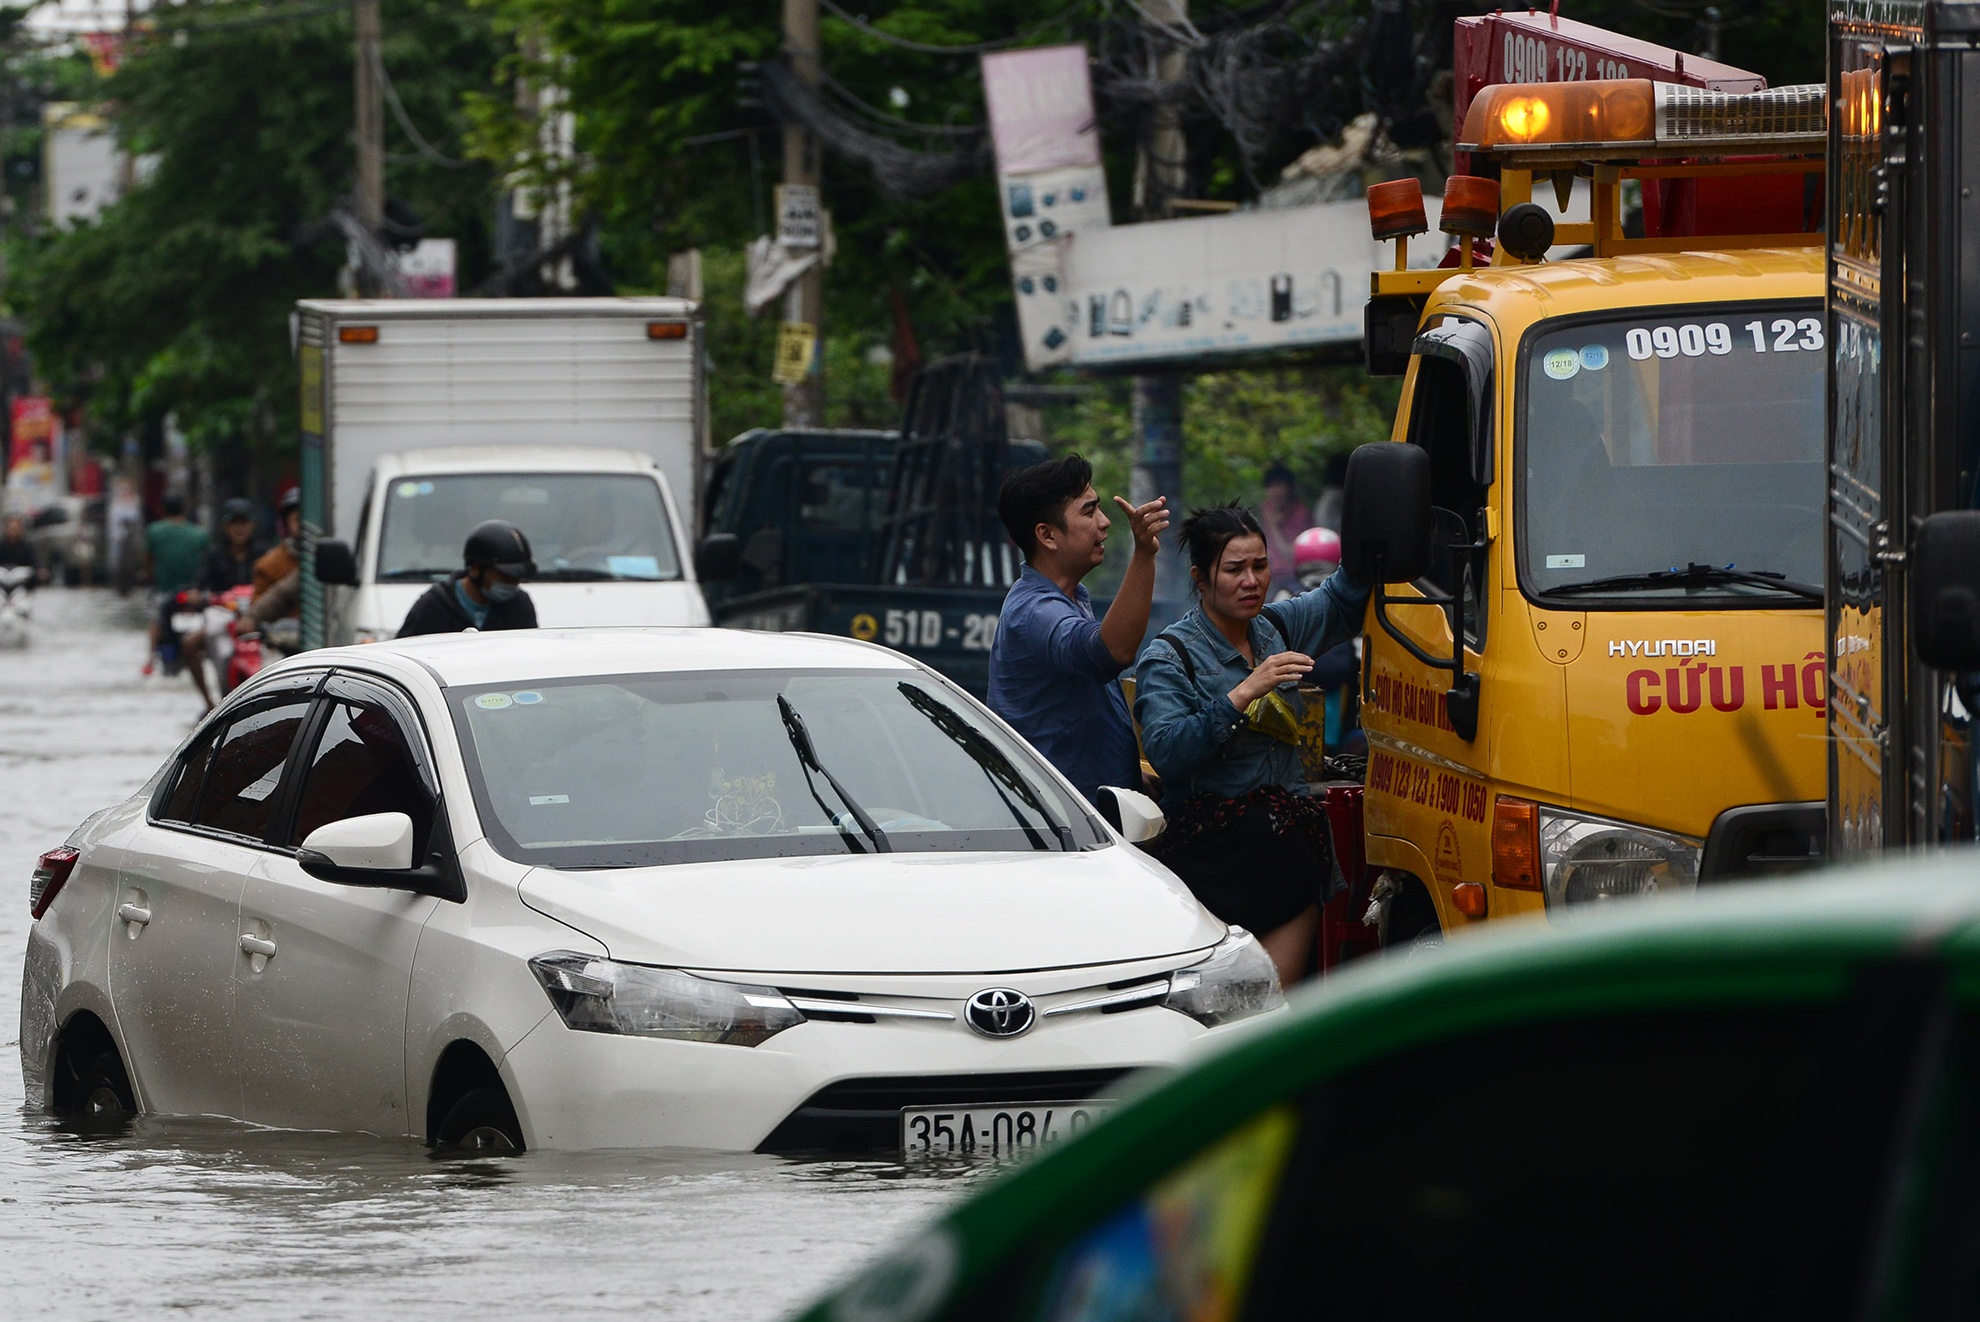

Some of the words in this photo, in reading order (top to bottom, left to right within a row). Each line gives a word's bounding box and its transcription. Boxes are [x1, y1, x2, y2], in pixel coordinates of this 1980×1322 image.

[1504, 31, 1547, 84] 0909
[1625, 322, 1733, 361] 0909
[1744, 318, 1825, 353] 123
[1551, 360, 1573, 368] 12/18
[885, 610, 941, 646] 51D
[1608, 639, 1716, 657] HYUNDAI
[1626, 657, 1745, 716] CỨU
[1761, 651, 1826, 718] HỘ
[1370, 752, 1394, 793] 0909
[1393, 759, 1411, 800] 123
[1411, 765, 1430, 805] 123
[1435, 772, 1460, 815] 1900
[1462, 781, 1488, 824] 1050
